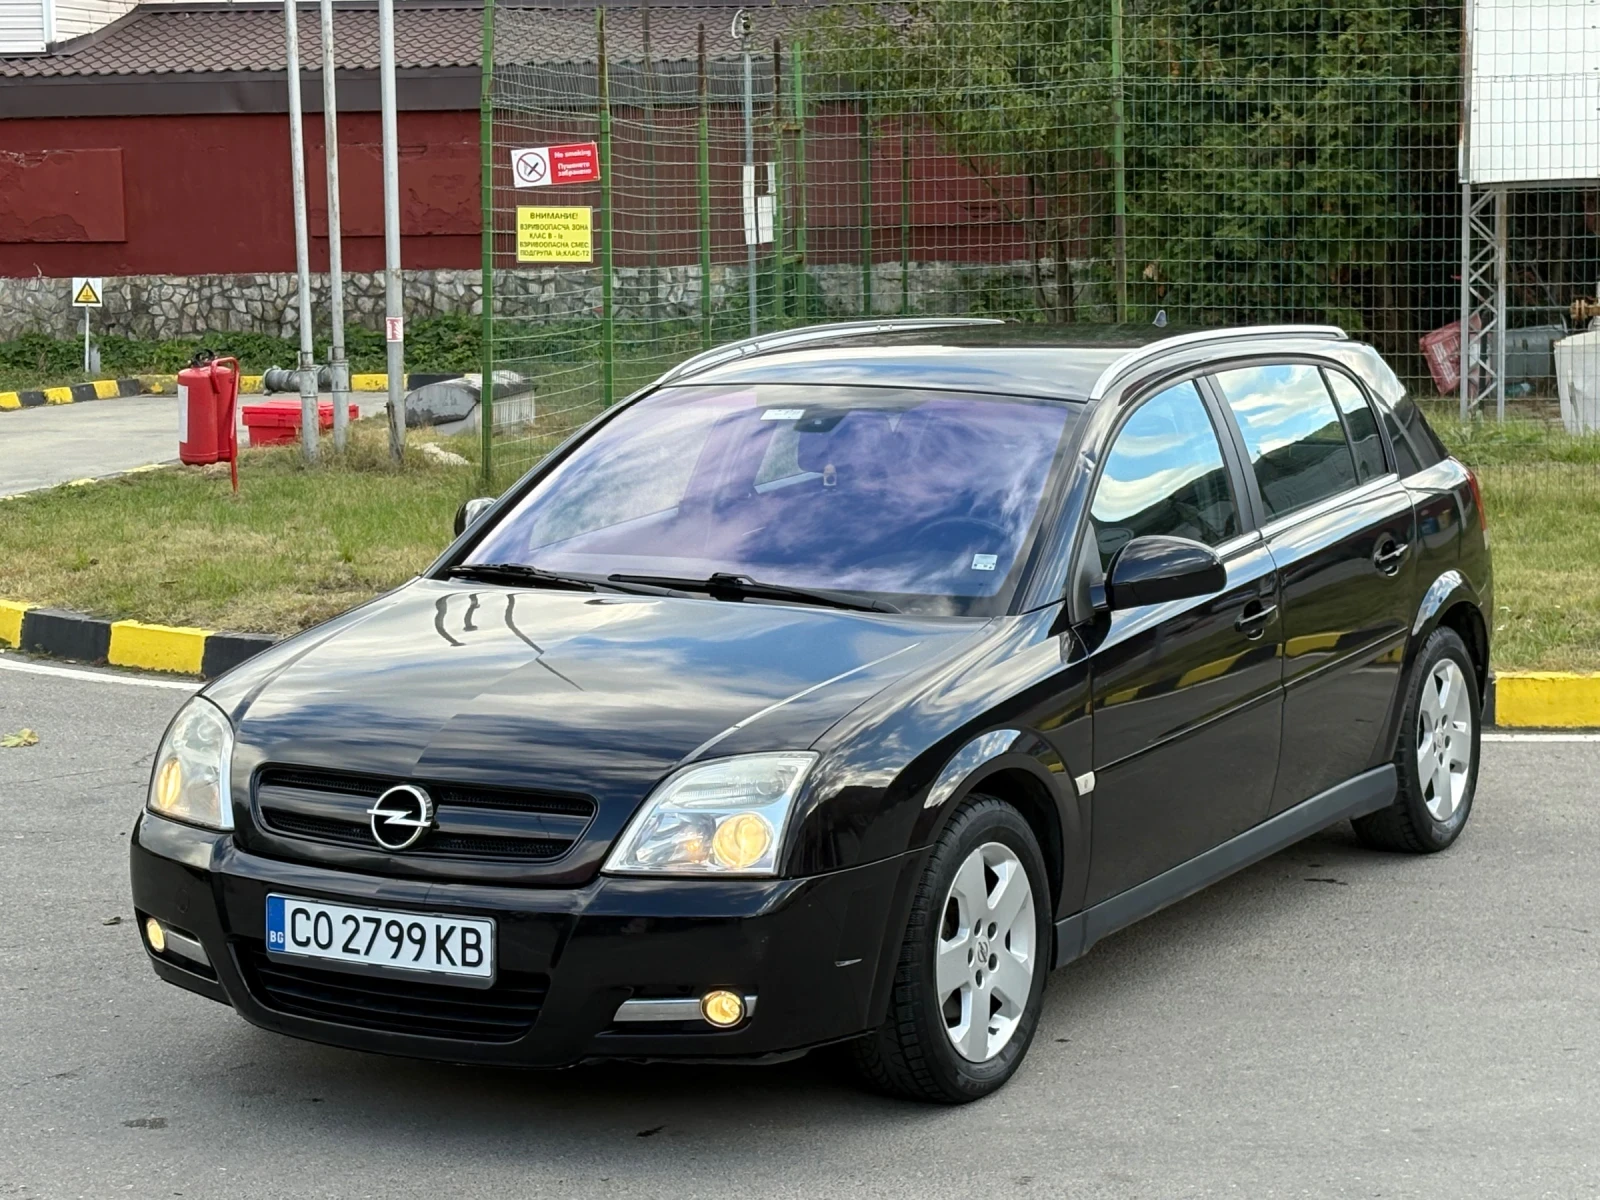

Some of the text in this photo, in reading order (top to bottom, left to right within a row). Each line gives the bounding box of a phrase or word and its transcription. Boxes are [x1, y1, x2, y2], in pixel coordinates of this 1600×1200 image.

[564, 149, 592, 158] smoking
[530, 212, 578, 220] ВНИМАНИЕ!
[269, 907, 484, 968] BG CO 2799 KB
